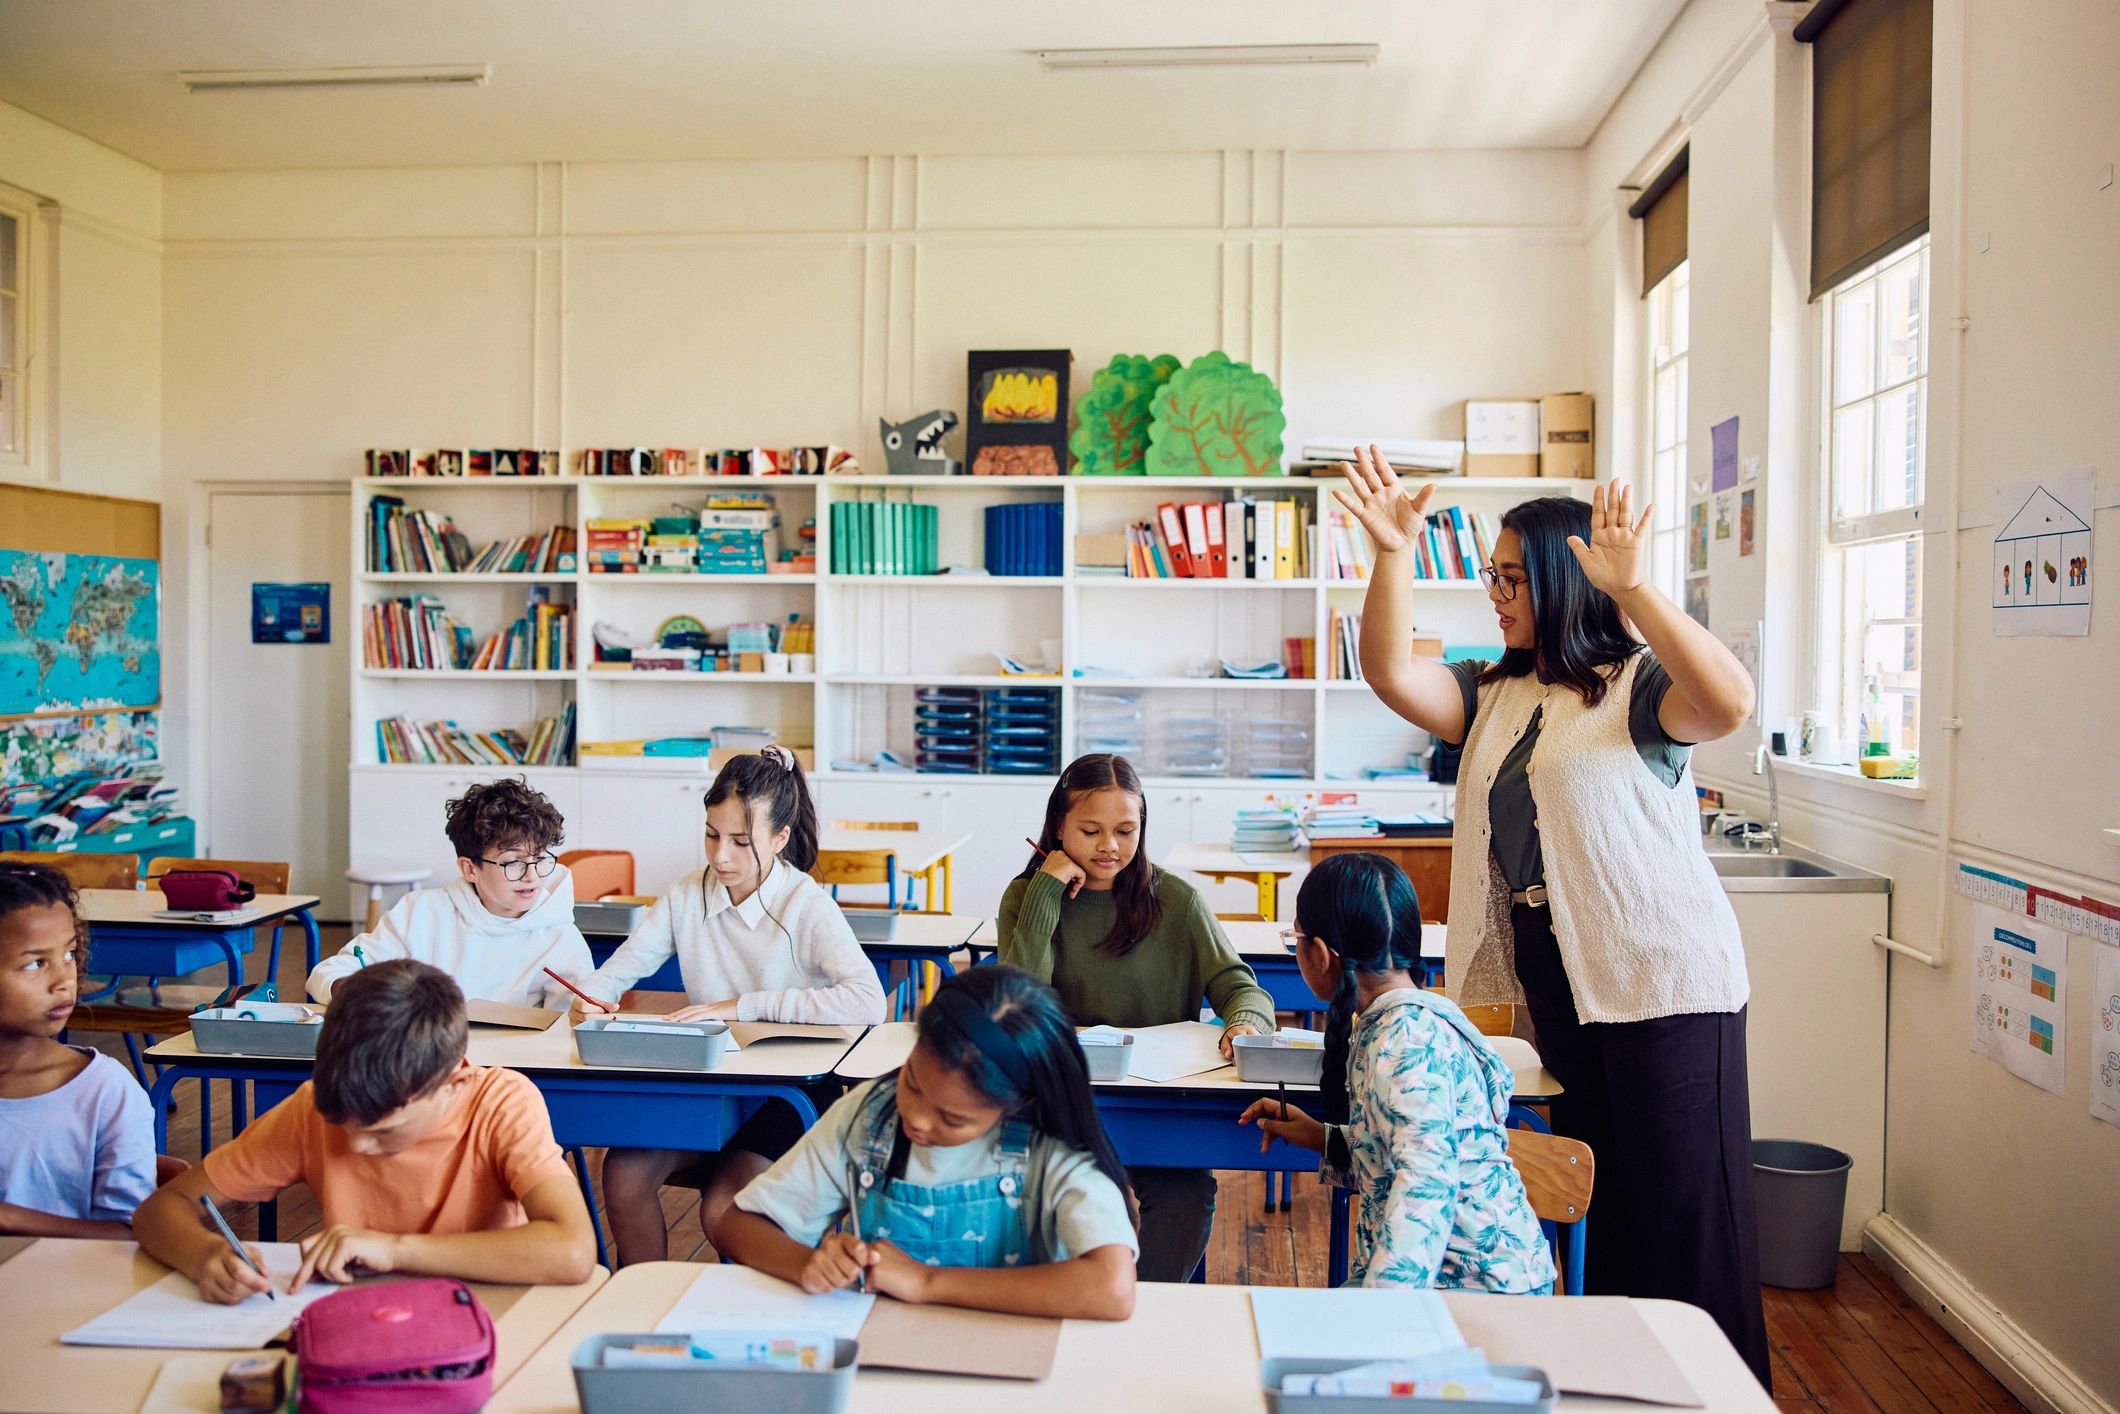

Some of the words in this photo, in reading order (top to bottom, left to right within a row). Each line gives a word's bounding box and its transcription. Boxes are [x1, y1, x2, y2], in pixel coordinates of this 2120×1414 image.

[1967, 879, 1972, 890] 2
[1975, 880, 1980, 892] 3
[1983, 883, 1988, 894] 4
[1991, 886, 1996, 896] 5
[1998, 888, 2003, 899] 6
[2006, 890, 2010, 902] 7
[2014, 893, 2019, 905] 8
[2022, 896, 2026, 908] 9
[2028, 898, 2035, 911] 10
[2036, 902, 2044, 914] 11
[2046, 904, 2054, 917] 12
[2056, 907, 2062, 920] 13
[2063, 910, 2071, 922] 14
[2072, 913, 2081, 926] 15
[2082, 916, 2089, 929] 16
[2090, 919, 2098, 932] 17
[2099, 922, 2108, 936] 18
[2110, 926, 2118, 940] 19
